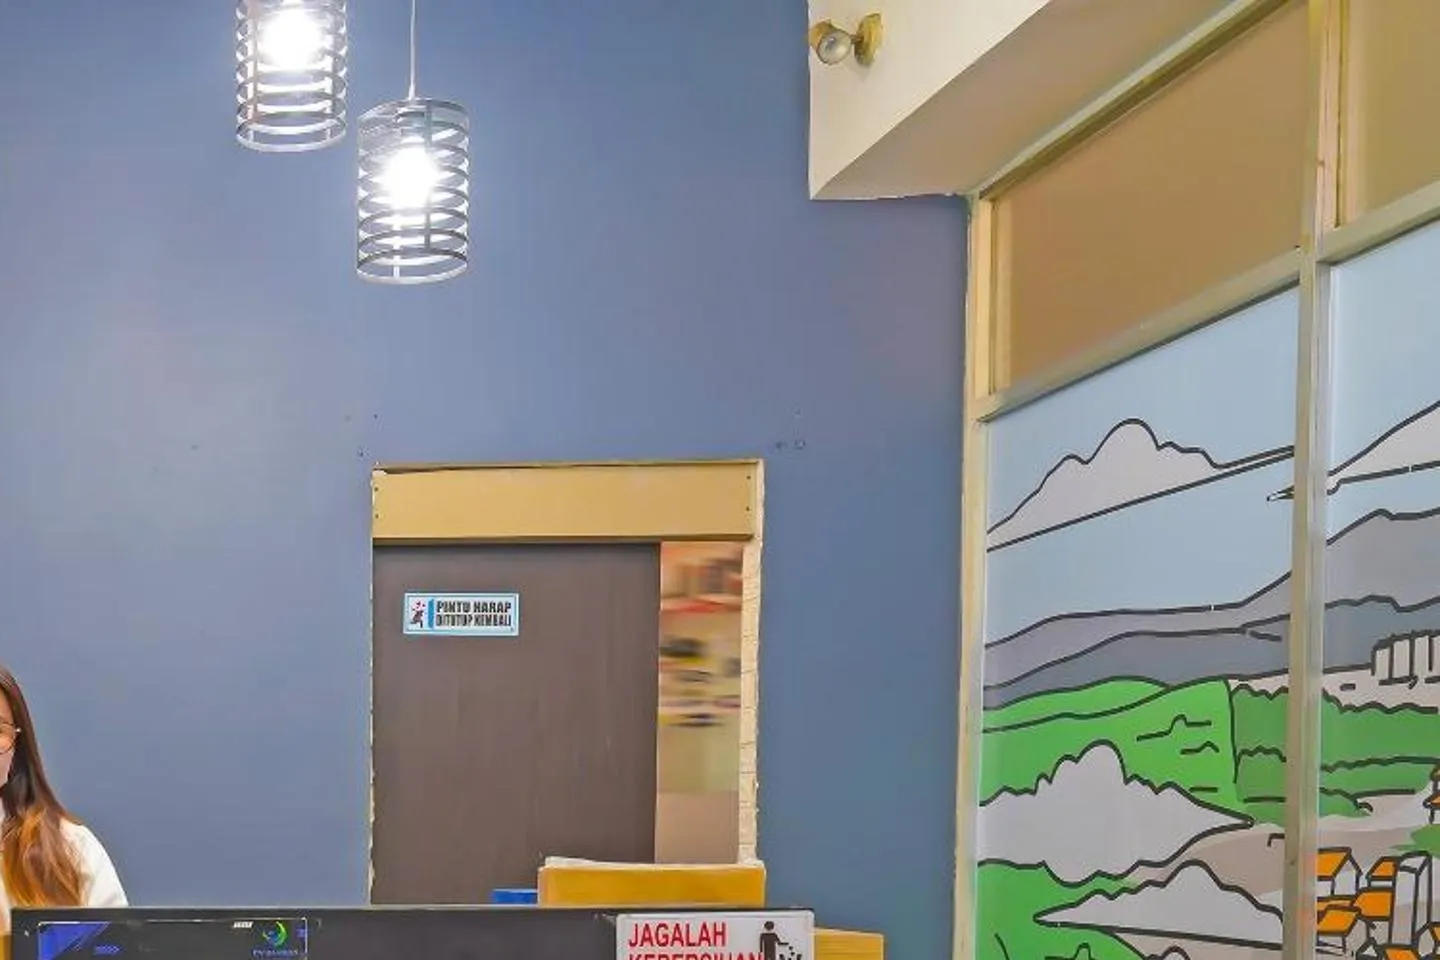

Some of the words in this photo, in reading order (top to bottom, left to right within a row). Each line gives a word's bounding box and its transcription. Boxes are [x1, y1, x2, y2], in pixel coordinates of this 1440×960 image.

[436, 601, 471, 613] PINTU
[473, 601, 512, 613] HARAP
[628, 921, 727, 948] JAGALAH
